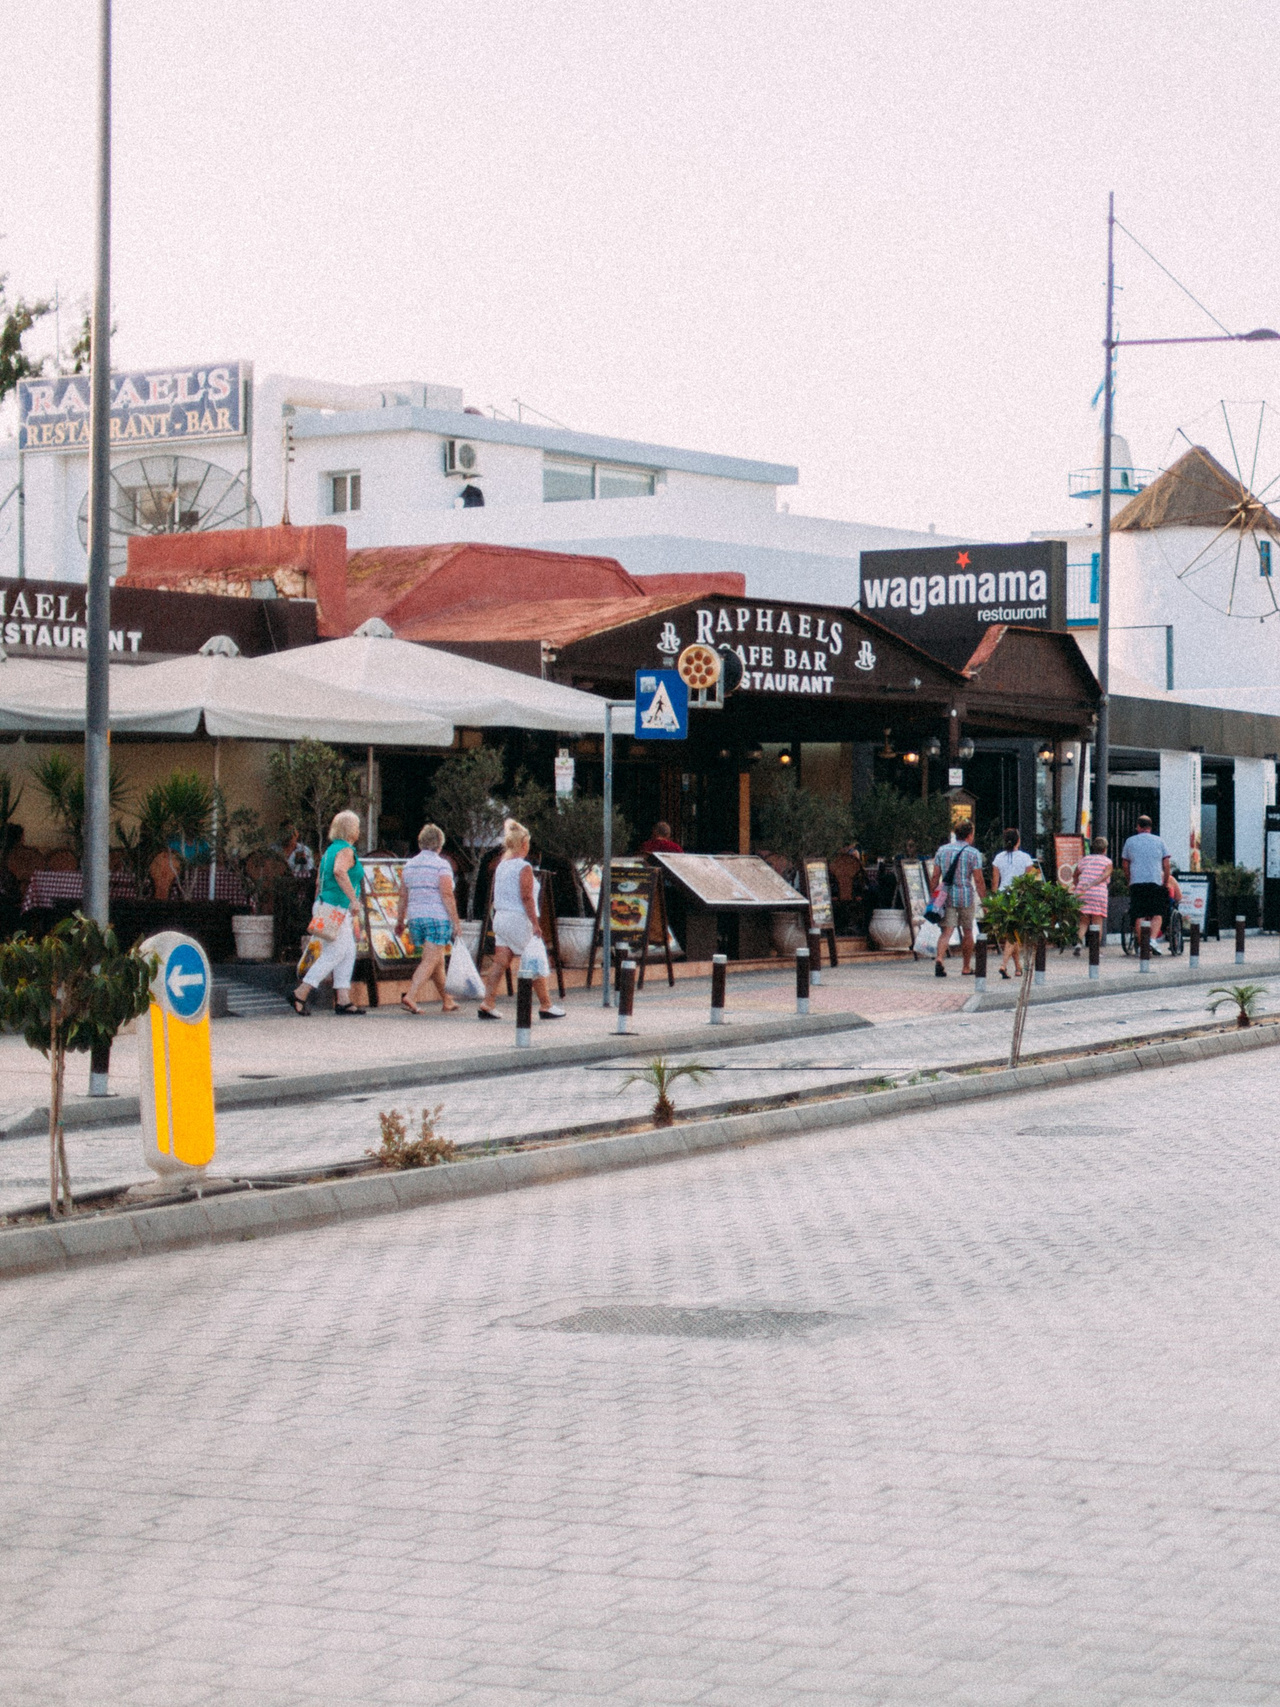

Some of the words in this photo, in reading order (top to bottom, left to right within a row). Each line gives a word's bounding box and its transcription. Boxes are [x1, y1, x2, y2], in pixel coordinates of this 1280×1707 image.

[27, 368, 231, 416] RAAEL'S
[26, 413, 172, 447] RESTARANT
[186, 406, 231, 434] BAR
[863, 569, 1047, 616] wagamama
[696, 607, 843, 655] RAPHAELS
[977, 605, 1047, 622] restaurant
[0, 621, 142, 653] STAURNT
[784, 648, 827, 672] BAR
